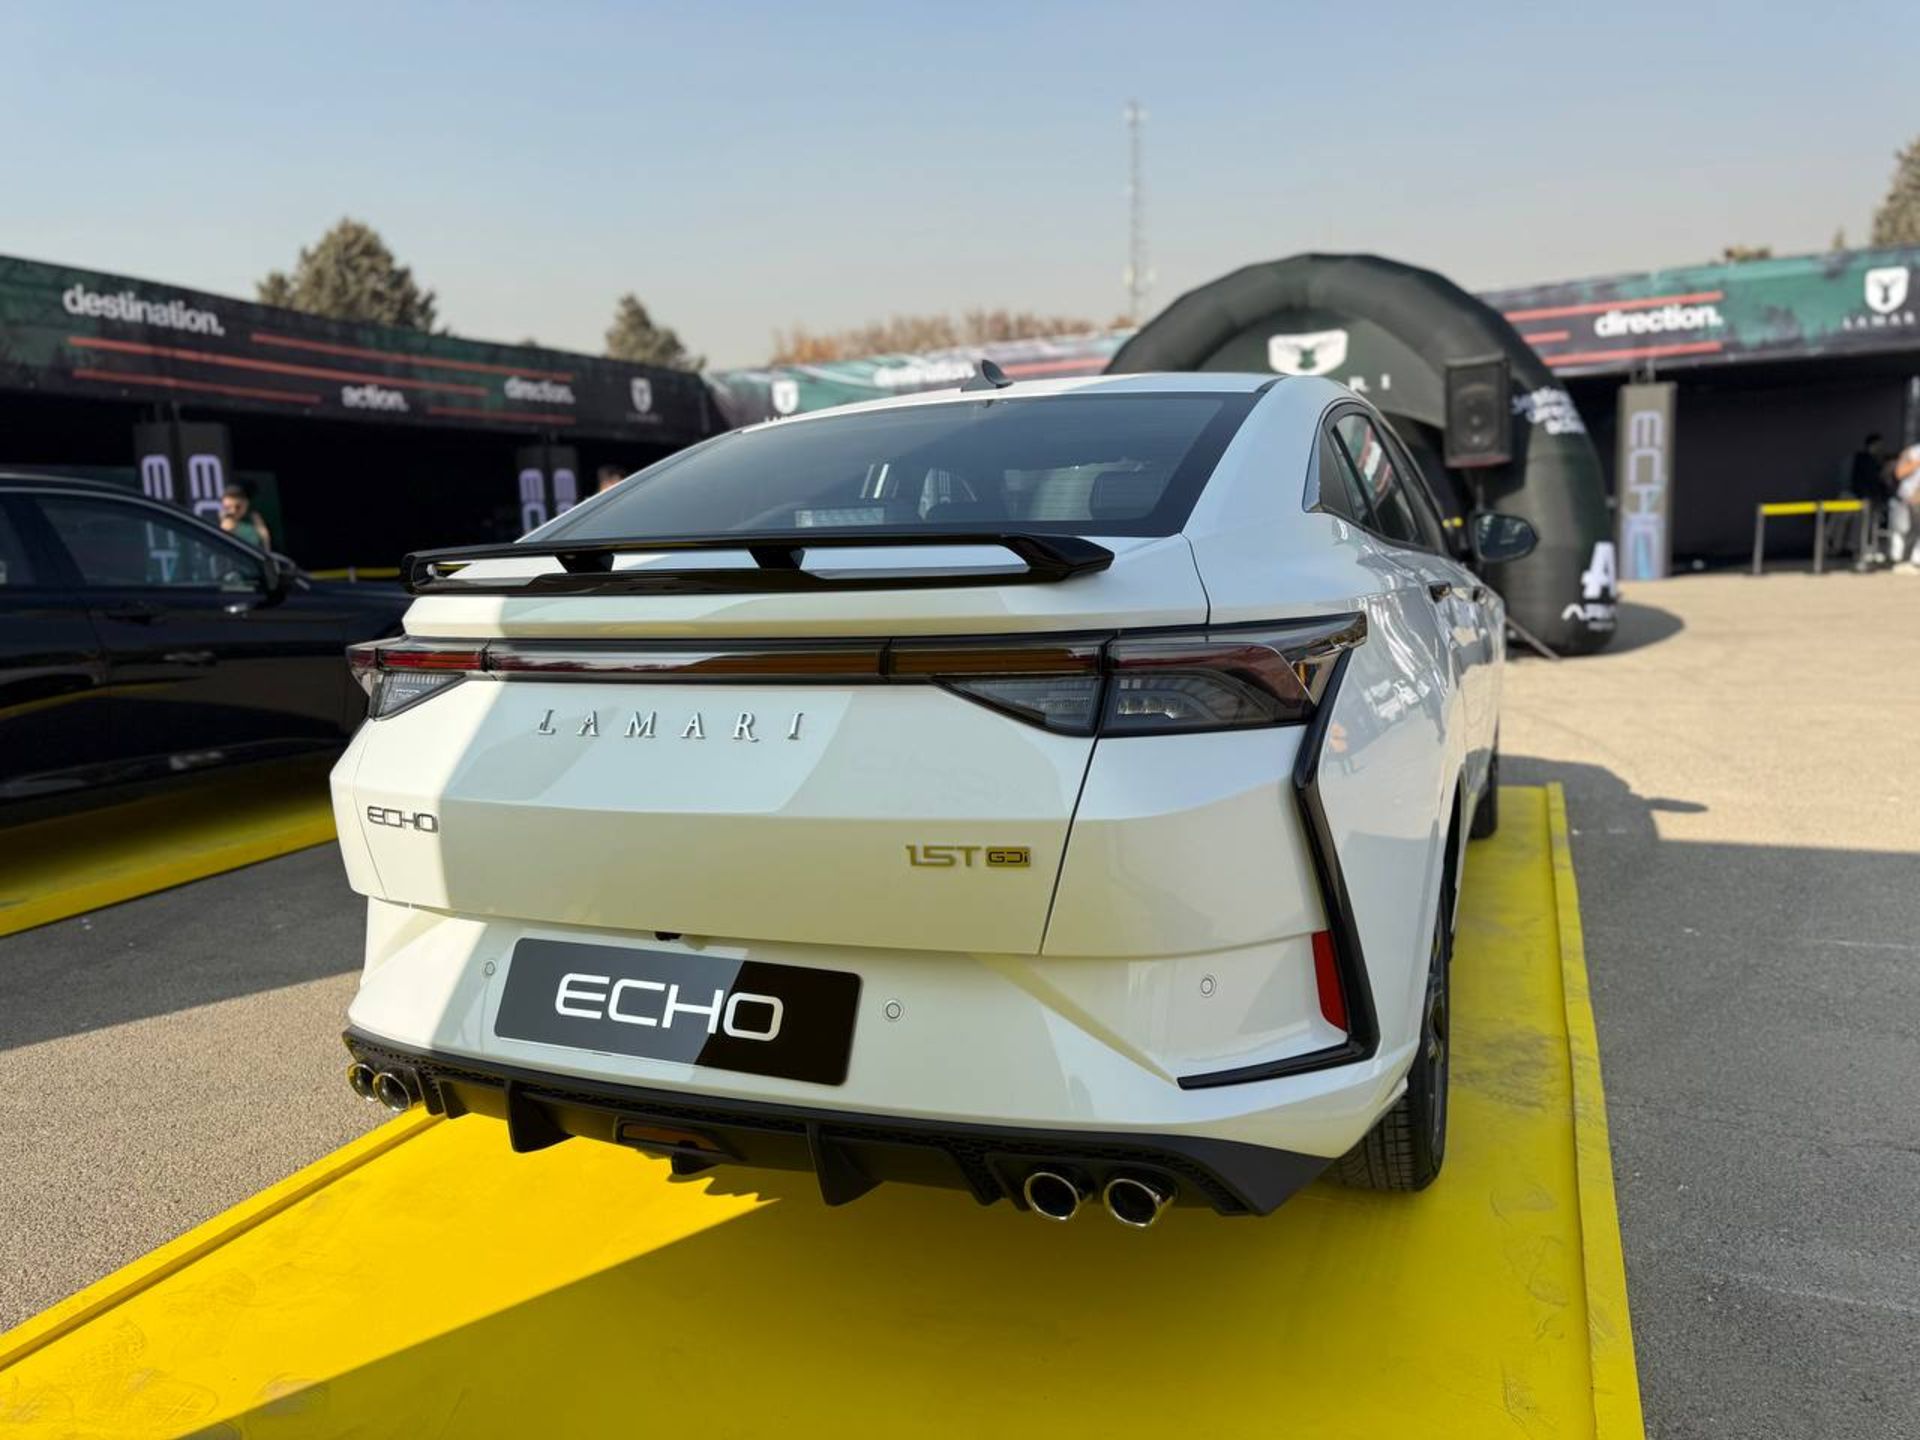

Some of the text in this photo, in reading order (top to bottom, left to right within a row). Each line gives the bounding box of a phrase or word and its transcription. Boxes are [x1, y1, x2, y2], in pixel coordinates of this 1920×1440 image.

[62, 283, 226, 336] destination.
[1594, 303, 1724, 337] direction.
[538, 708, 805, 743] LAMARI
[367, 805, 438, 834] ECHO
[555, 972, 784, 1042] ECHO
